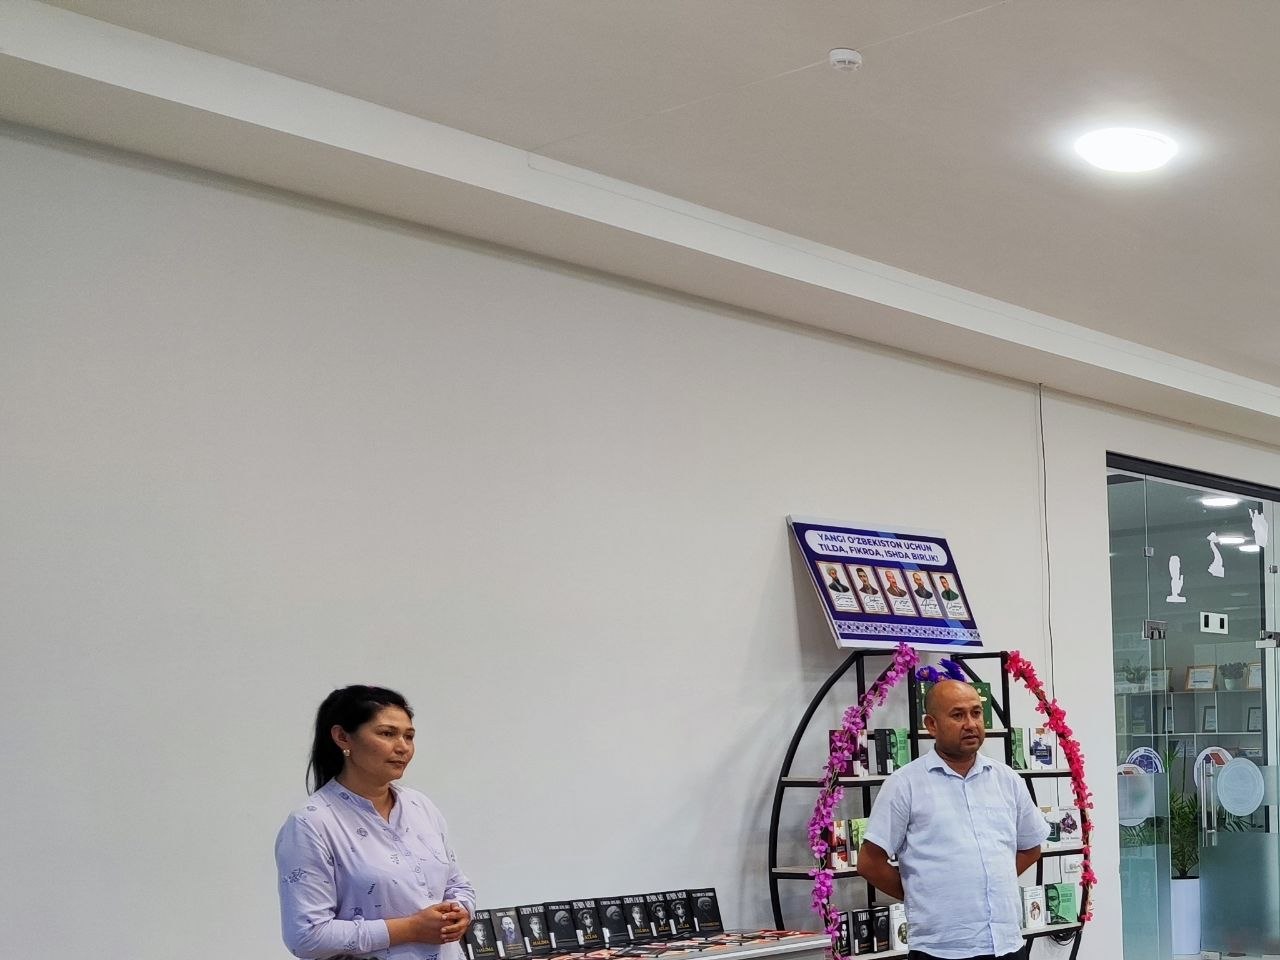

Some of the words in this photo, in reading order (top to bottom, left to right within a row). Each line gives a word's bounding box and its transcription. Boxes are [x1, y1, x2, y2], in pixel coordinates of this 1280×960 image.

[817, 533, 846, 543] YANGI
[904, 542, 932, 552] UCHUN
[818, 543, 848, 554] TILDA,
[850, 547, 884, 558] FIKRDA,
[885, 550, 911, 559] ISHDA
